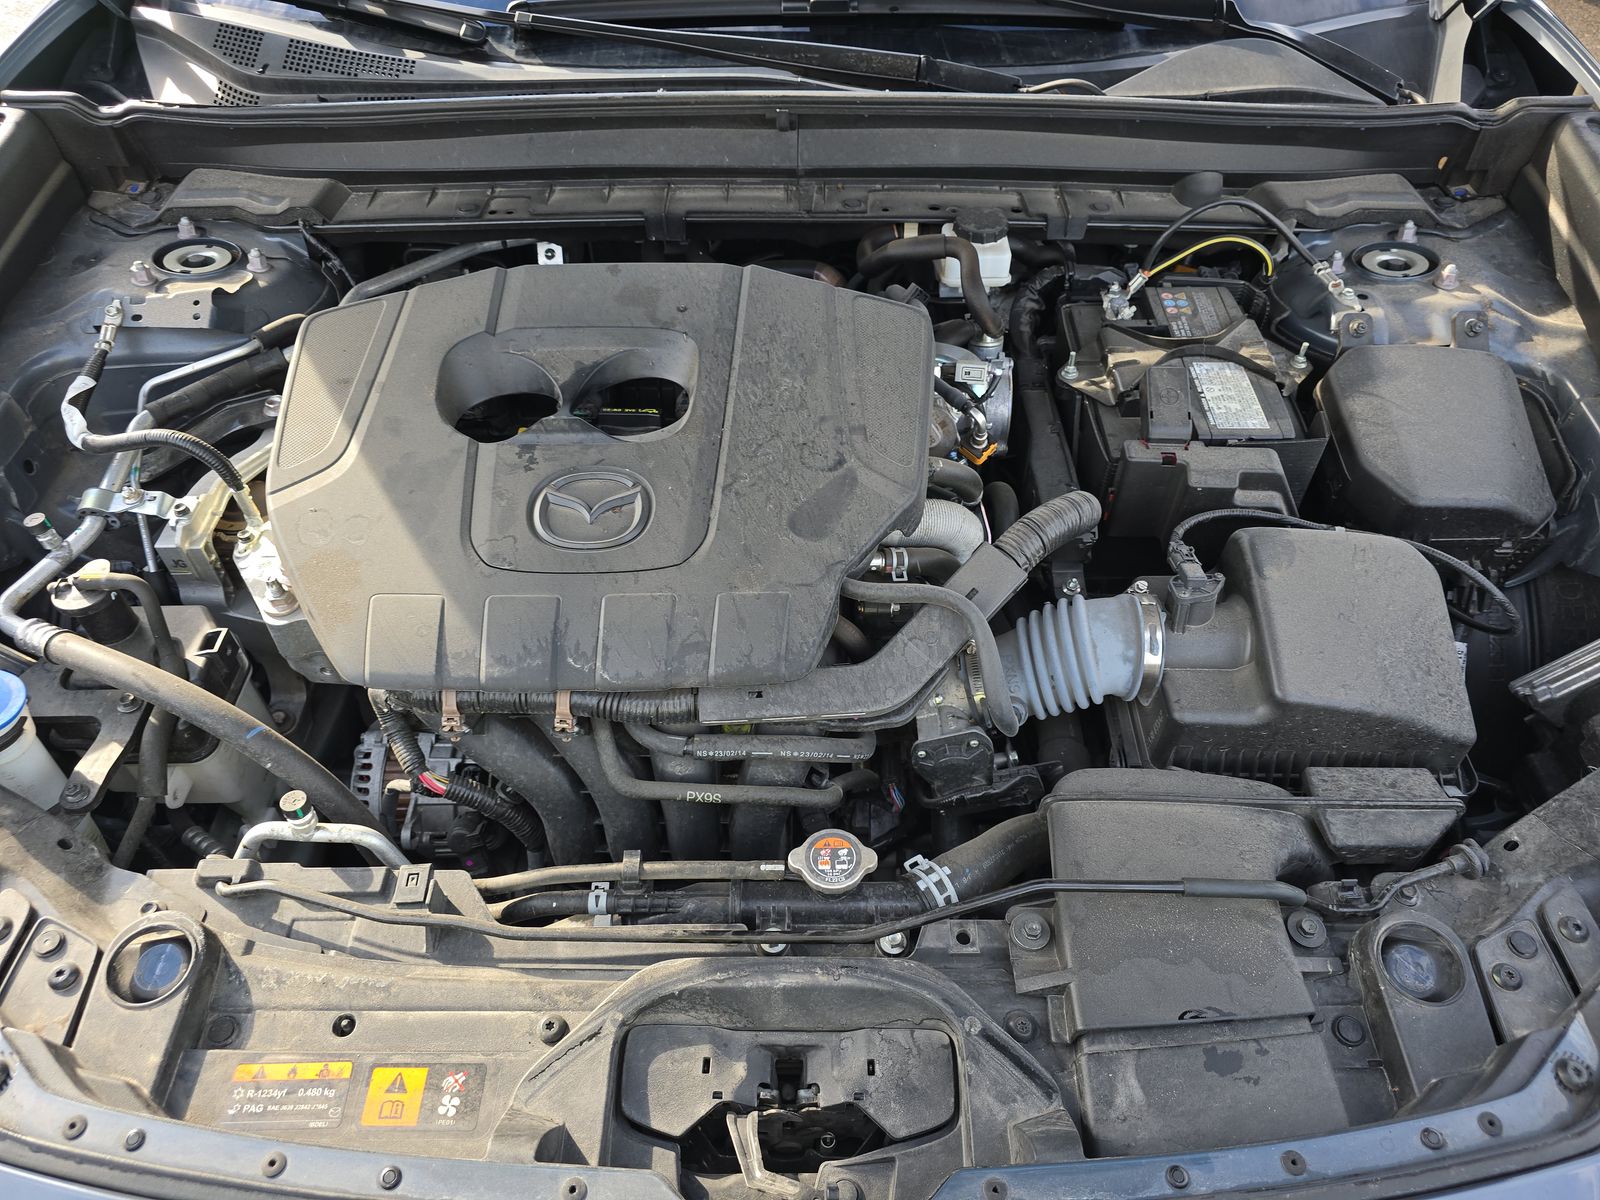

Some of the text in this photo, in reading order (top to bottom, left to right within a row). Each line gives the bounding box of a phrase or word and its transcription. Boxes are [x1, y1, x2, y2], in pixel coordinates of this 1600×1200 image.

[686, 790, 722, 803] PX9S
[246, 1087, 336, 1099] R-1234yf 0.480 kg
[242, 1104, 264, 1113] PAG
